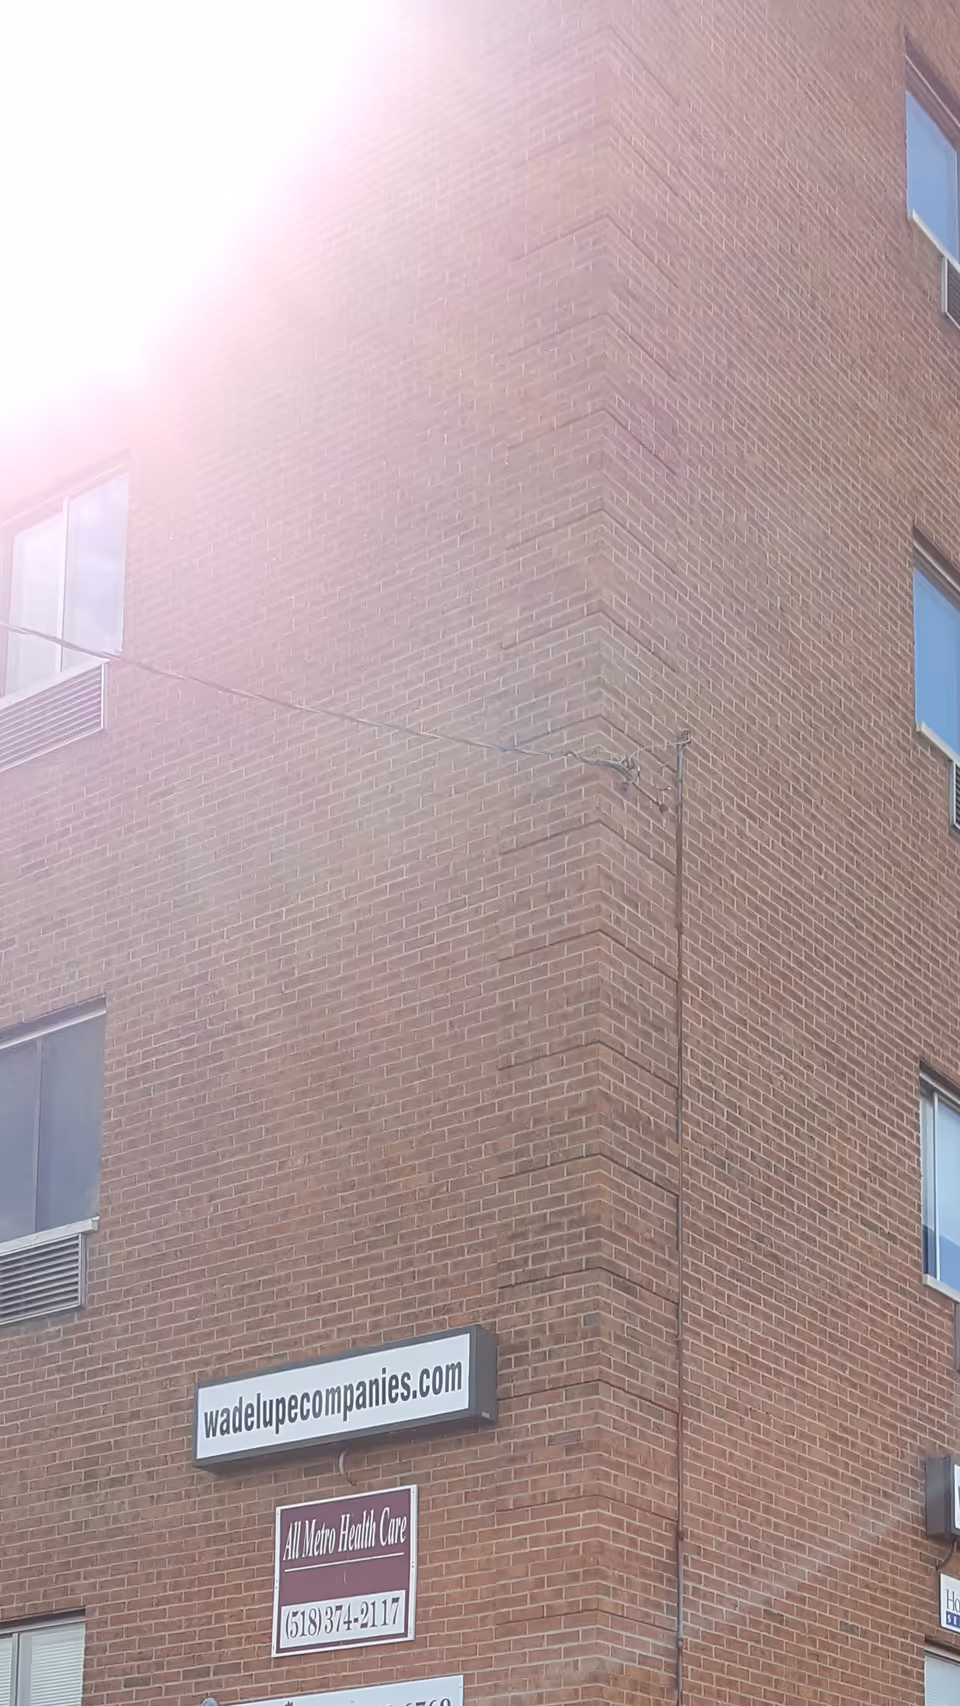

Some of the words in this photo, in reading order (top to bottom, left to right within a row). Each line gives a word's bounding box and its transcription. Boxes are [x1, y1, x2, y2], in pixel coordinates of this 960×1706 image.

[203, 1360, 463, 1439] wadelupecompanies.com
[282, 1520, 301, 1561] All
[301, 1518, 337, 1558] Metro
[338, 1508, 377, 1553] Health
[380, 1506, 408, 1547] Care
